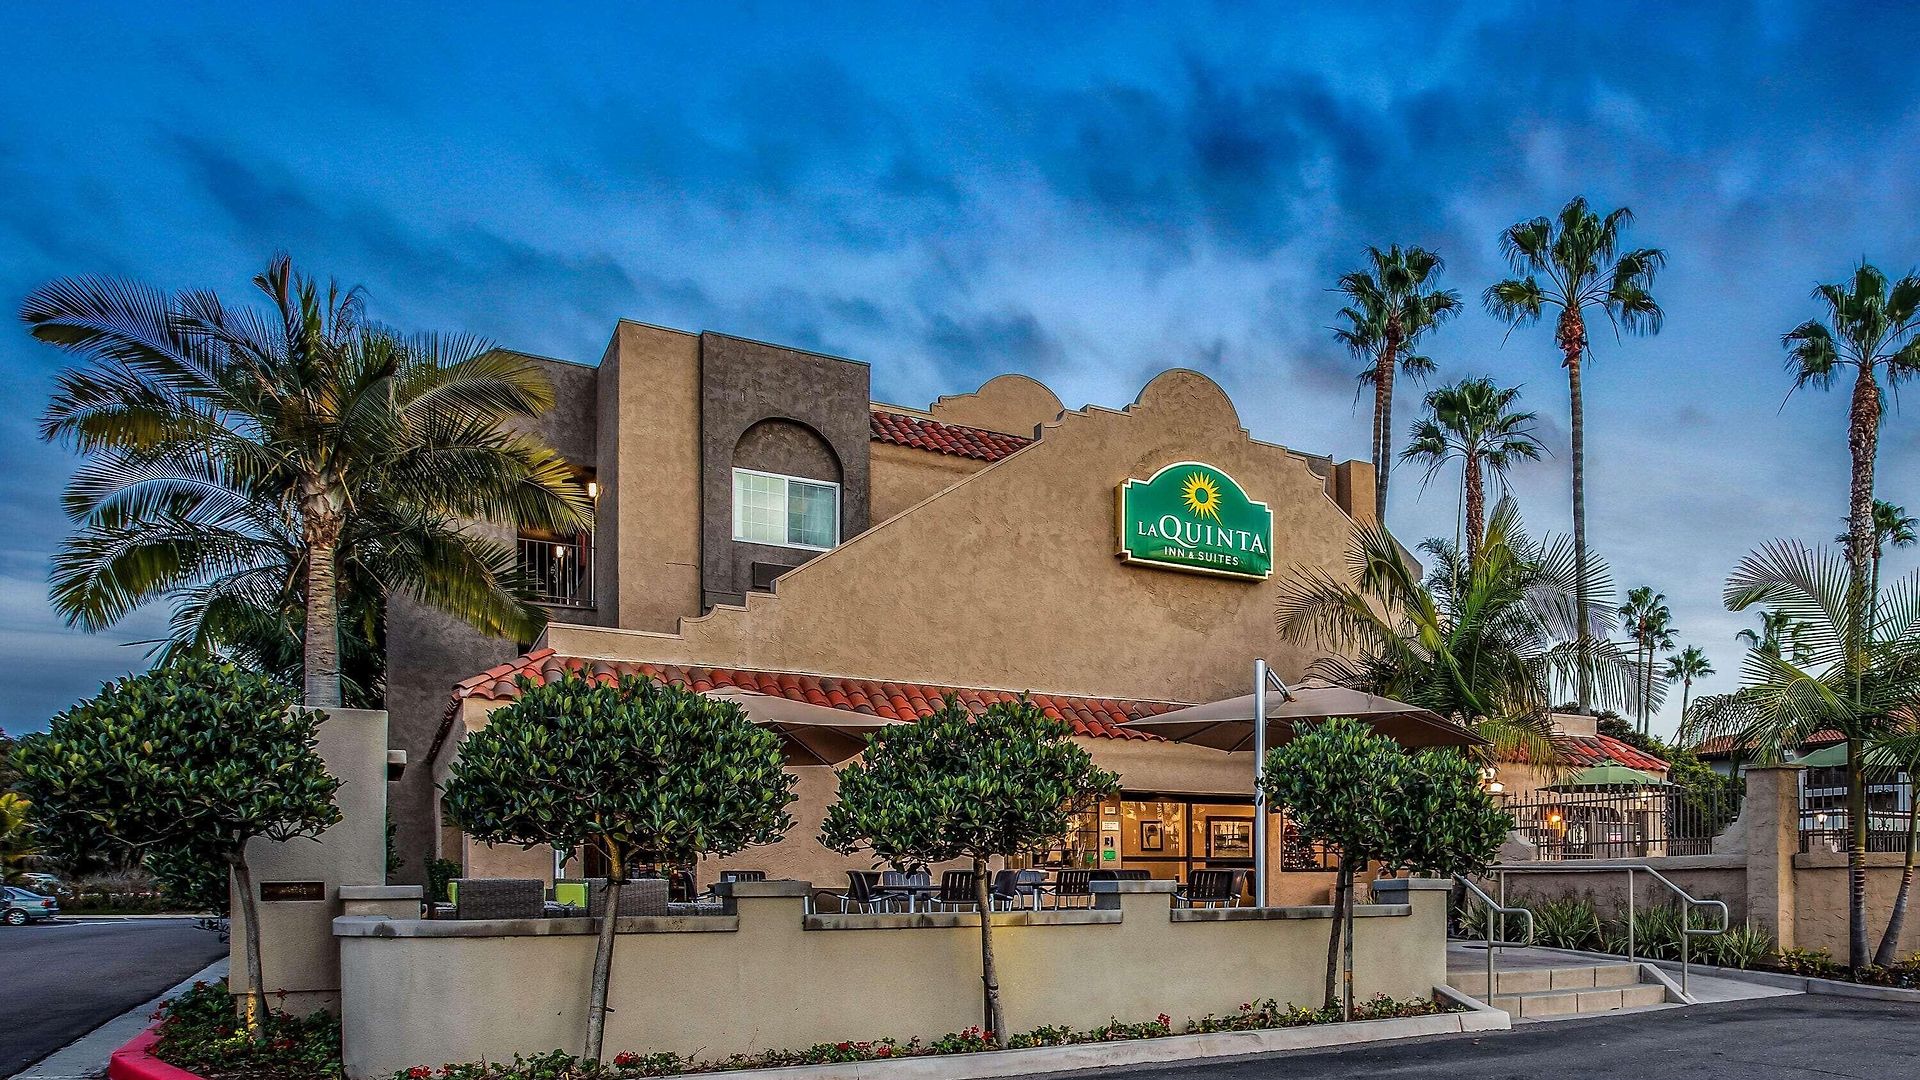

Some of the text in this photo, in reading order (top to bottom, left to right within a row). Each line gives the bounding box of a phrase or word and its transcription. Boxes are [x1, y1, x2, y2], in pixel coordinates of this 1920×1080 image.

[1138, 514, 1266, 554] LA QUINTA
[1164, 546, 1239, 566] INN & SUITES
